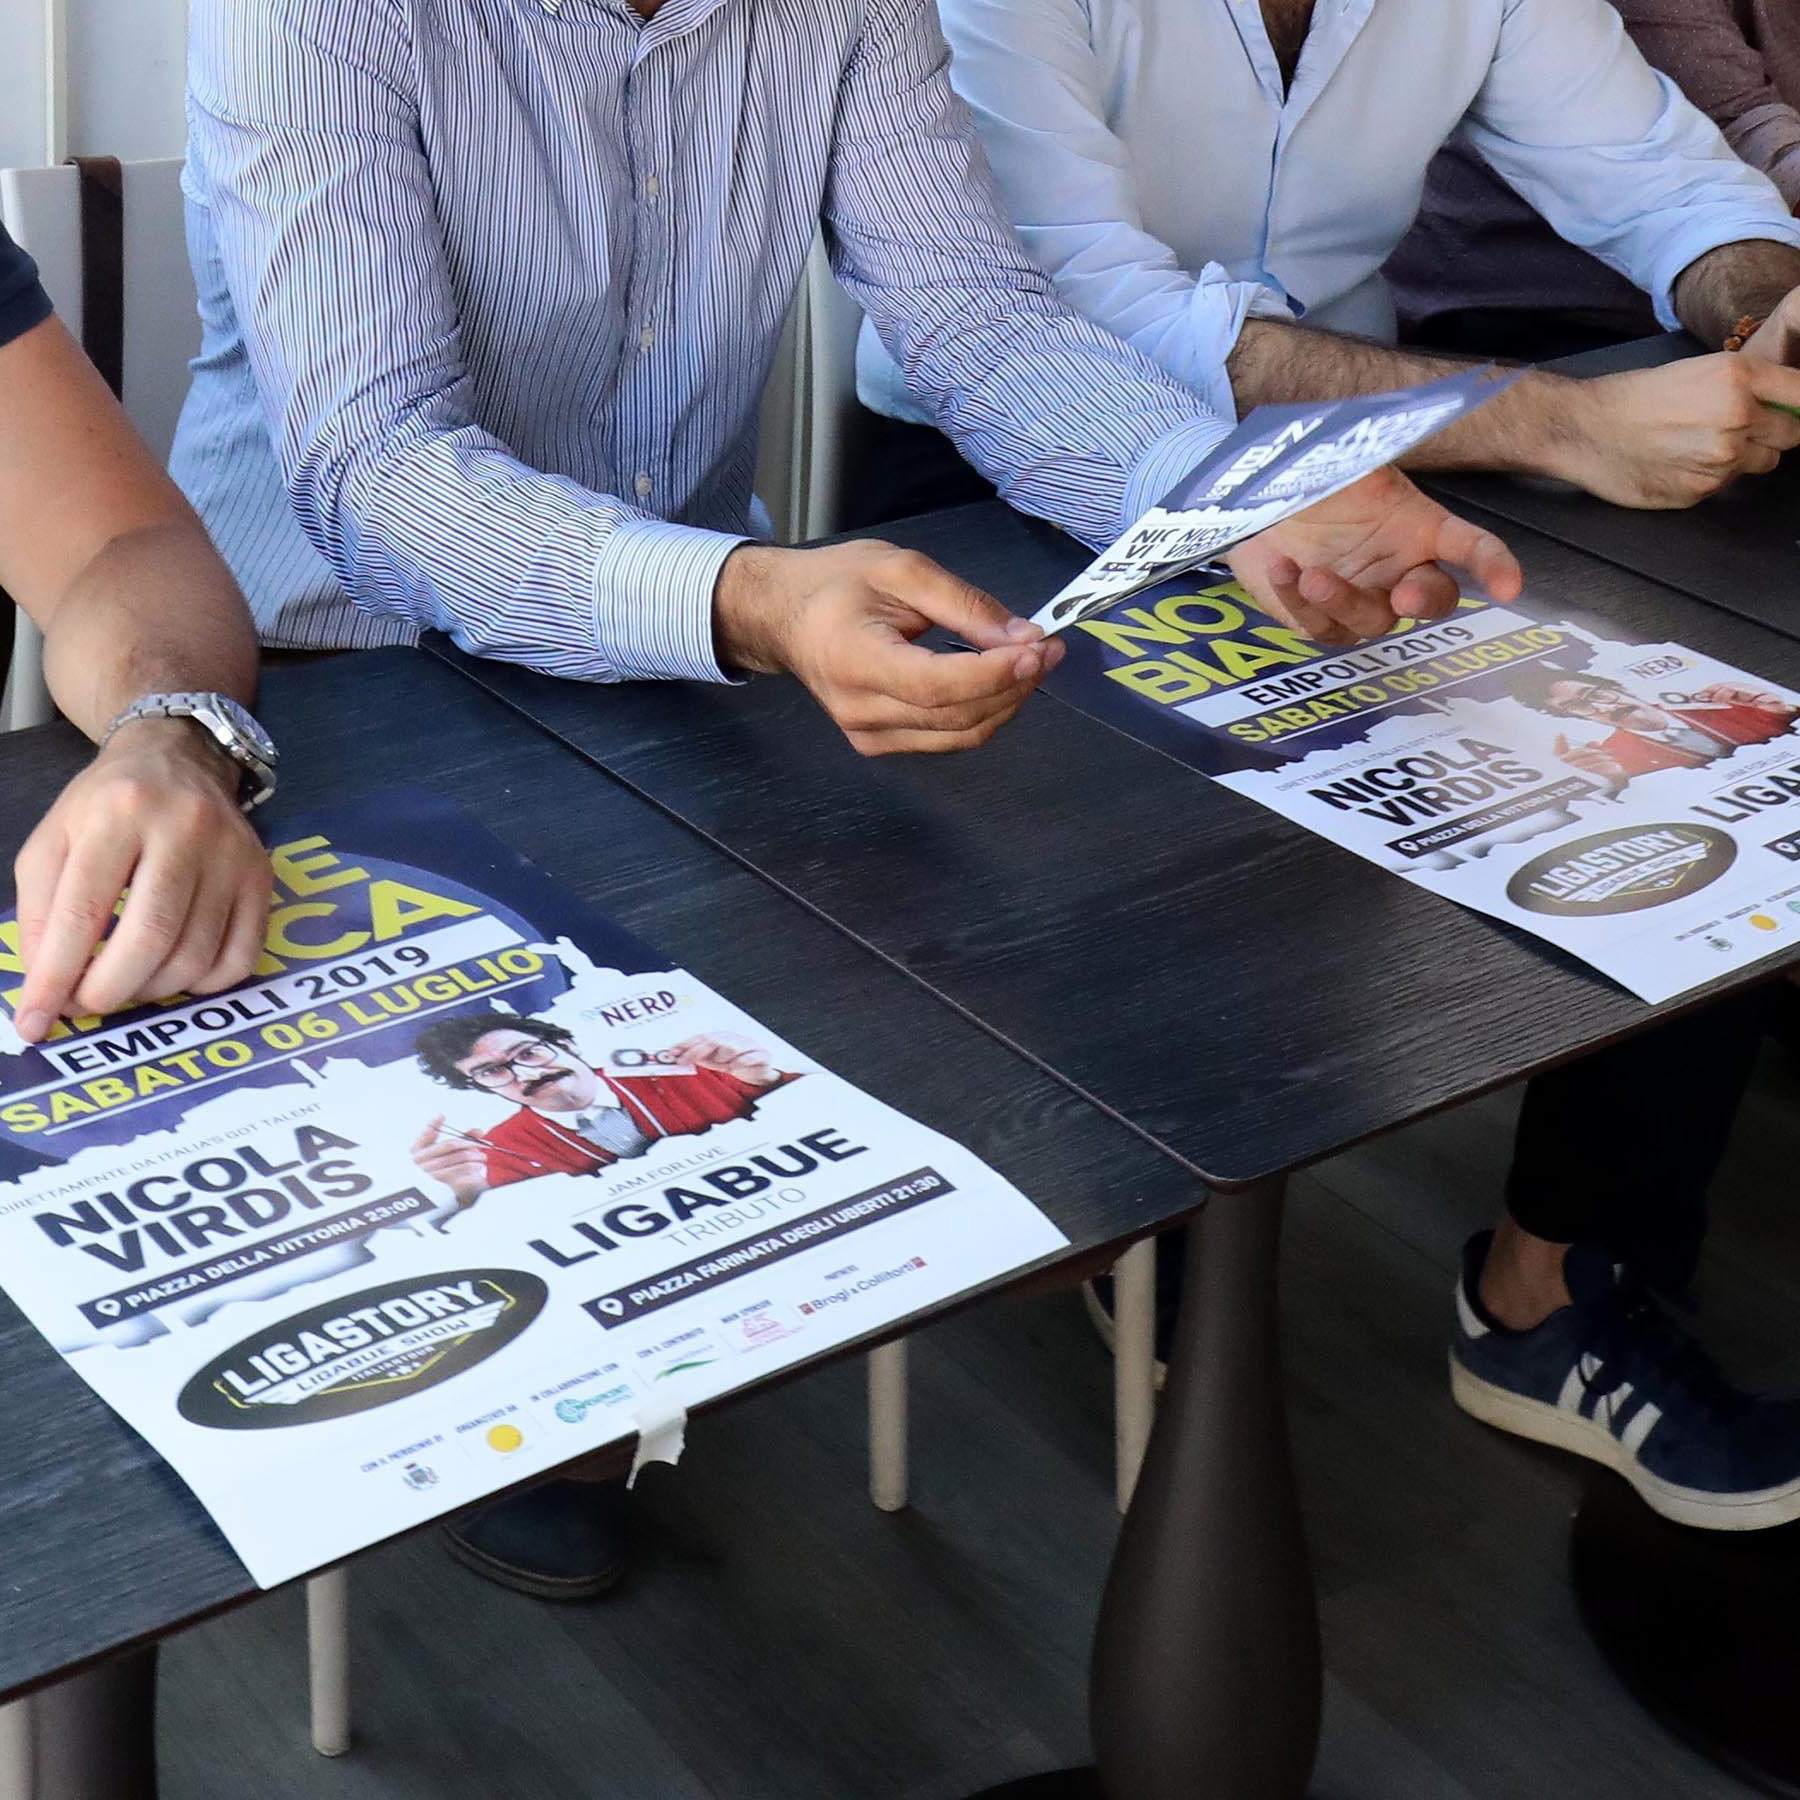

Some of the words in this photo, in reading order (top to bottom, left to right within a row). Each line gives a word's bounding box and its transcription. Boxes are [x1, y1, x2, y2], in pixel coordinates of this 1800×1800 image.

[1228, 683, 1389, 744] SABATO
[1386, 666, 1441, 693] 06
[1430, 626, 1564, 677] LUGLIO
[1240, 651, 1384, 705] EMPOLI
[1383, 626, 1476, 662] 2019
[1628, 655, 1686, 680] NERD
[1306, 737, 1515, 810] NICOLA
[1357, 760, 1544, 827] VIRDIS
[1530, 830, 1687, 898] LIGASTORY
[58, 988, 290, 1073] EMPOLI
[295, 943, 430, 999] 2019
[259, 1006, 338, 1055] 06
[341, 947, 545, 1028] LUGLIO
[599, 989, 678, 1028] NERD
[32, 1123, 360, 1248] NICOLA
[525, 1127, 871, 1269] LIGABUE
[605, 1171, 646, 1198] JAM
[646, 1158, 688, 1182] FOR
[688, 1145, 729, 1168] LIVE
[81, 1159, 373, 1274] VIRDIS
[129, 1275, 205, 1309] PIAZZA
[205, 1251, 270, 1280] DELLA
[269, 1218, 361, 1256] VITTORIA
[355, 1196, 421, 1225] 23:00
[628, 1272, 704, 1306] PIAZZA
[697, 1237, 787, 1279] FARINATA
[780, 1214, 837, 1246] DEGLI
[831, 1192, 900, 1225] UBERTI
[890, 1173, 943, 1201] 21:30
[660, 1187, 808, 1248] TRIBUTO
[813, 1287, 850, 1312] Brogi
[857, 1260, 918, 1293] Collitorti
[221, 1280, 488, 1397] LIGASTORY
[295, 1344, 391, 1392] LIGABUE
[399, 1316, 472, 1351] SHOW
